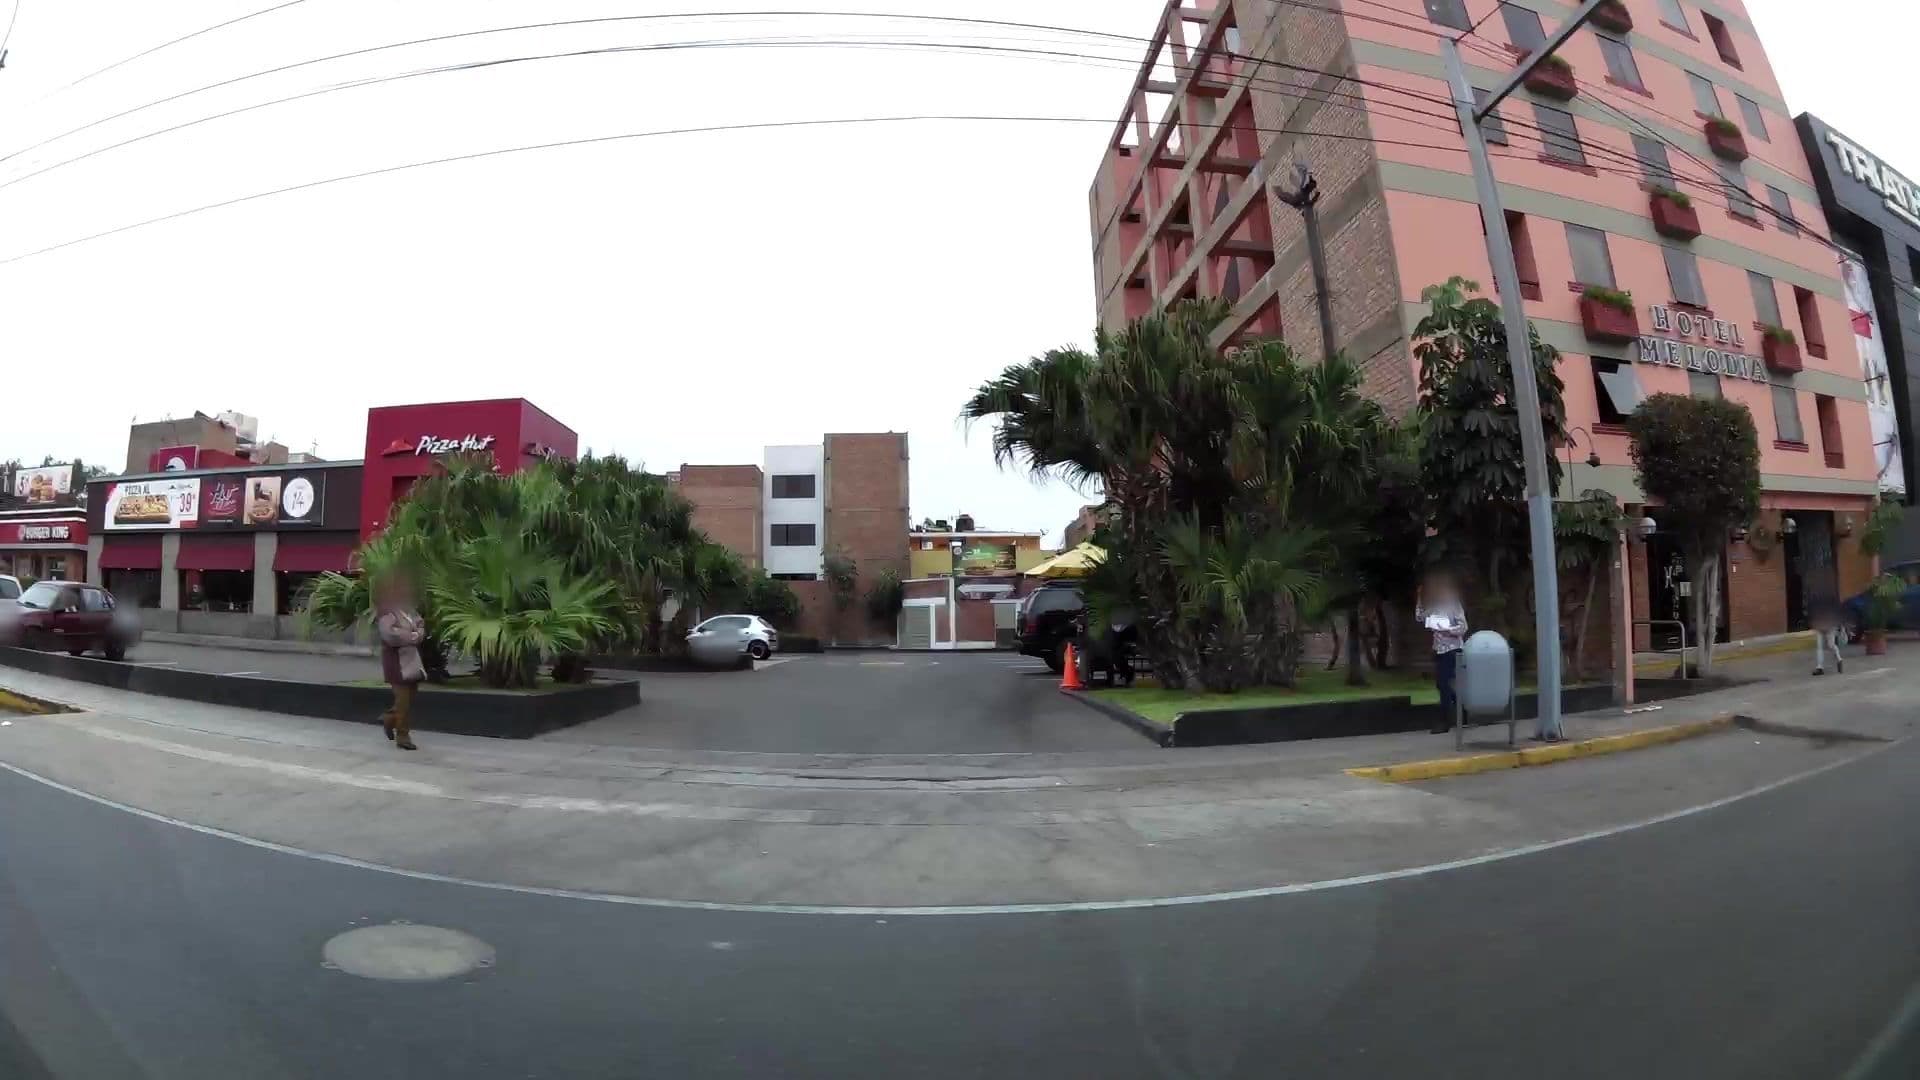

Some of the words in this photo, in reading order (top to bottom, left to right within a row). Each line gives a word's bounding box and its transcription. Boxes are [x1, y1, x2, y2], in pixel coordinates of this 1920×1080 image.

[1650, 305, 1745, 347] HOTEL
[1638, 335, 1769, 383] MELODIA
[415, 436, 459, 455] Pizza
[460, 433, 495, 452] Hut
[25, 526, 49, 538] BURGER
[49, 526, 69, 538] KING
